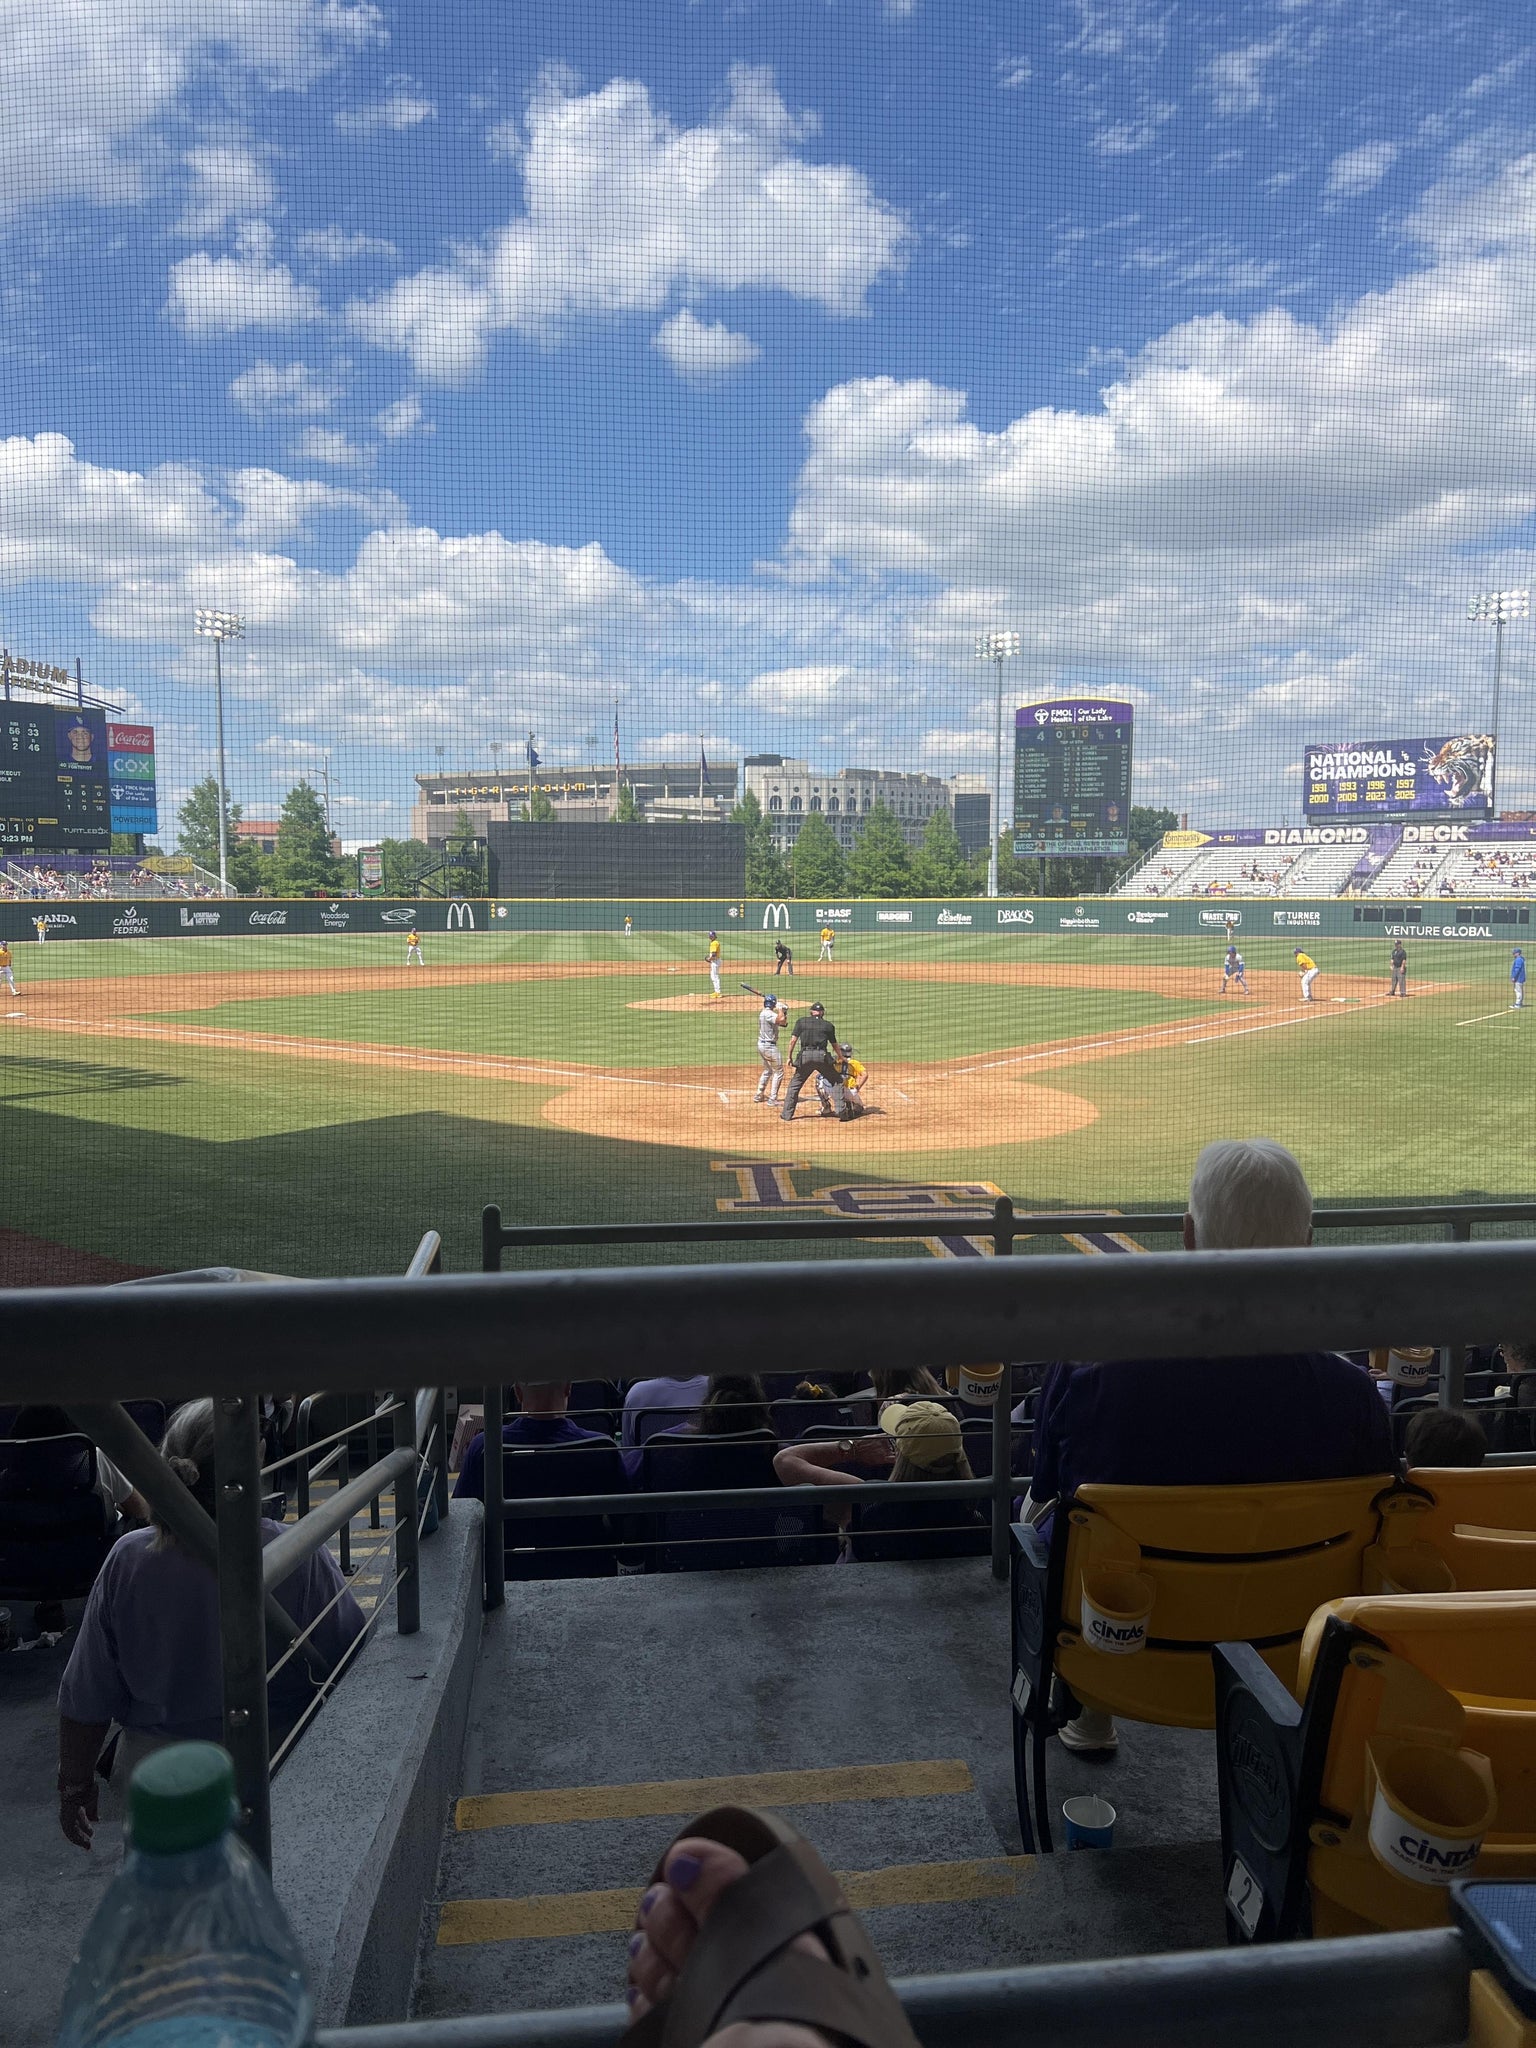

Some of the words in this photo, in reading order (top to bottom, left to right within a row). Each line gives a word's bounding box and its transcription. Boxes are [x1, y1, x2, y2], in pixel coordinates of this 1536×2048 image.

[0, 655, 68, 684] ADIUM
[11, 676, 53, 694] FIELD
[1051, 709, 1073, 717] FMOL
[1091, 707, 1107, 716] Lady
[9, 727, 20, 735] 56
[28, 729, 39, 737] 33
[1037, 731, 1045, 741] 4
[28, 744, 40, 752] 46
[1310, 750, 1397, 768] NATIONAL
[114, 759, 150, 773] COX
[1310, 762, 1416, 781] CHAMPIONS
[455, 785, 500, 795] TIGER
[512, 782, 587, 794] STADIUM
[1311, 783, 1328, 793] 1991
[1339, 781, 1357, 792] 1993
[1367, 780, 1386, 790] 1996
[1396, 779, 1415, 789] 1997
[1337, 792, 1357, 802] 2009
[1365, 791, 1387, 801] 2023
[1394, 789, 1416, 800] 2025
[28, 824, 34, 832] 0
[1264, 827, 1368, 845] DIAMOND
[1402, 825, 1469, 842] DECK
[249, 910, 289, 925] Coca-Cola
[320, 911, 350, 920] Woodside
[828, 909, 852, 918] BASF
[997, 909, 1034, 924] DRAGO'S
[1202, 912, 1224, 920] WASTE
[1225, 912, 1239, 920] PRO
[1286, 911, 1320, 920] TURNER
[113, 918, 148, 926] CAMPUS
[324, 919, 346, 928] Energy
[1060, 917, 1100, 926] Higginbotham
[113, 926, 149, 935] FEDERAL
[1385, 925, 1440, 936] VENTURE
[1442, 926, 1493, 937] GLOBAL
[1236, 1876, 1251, 1917] 2
